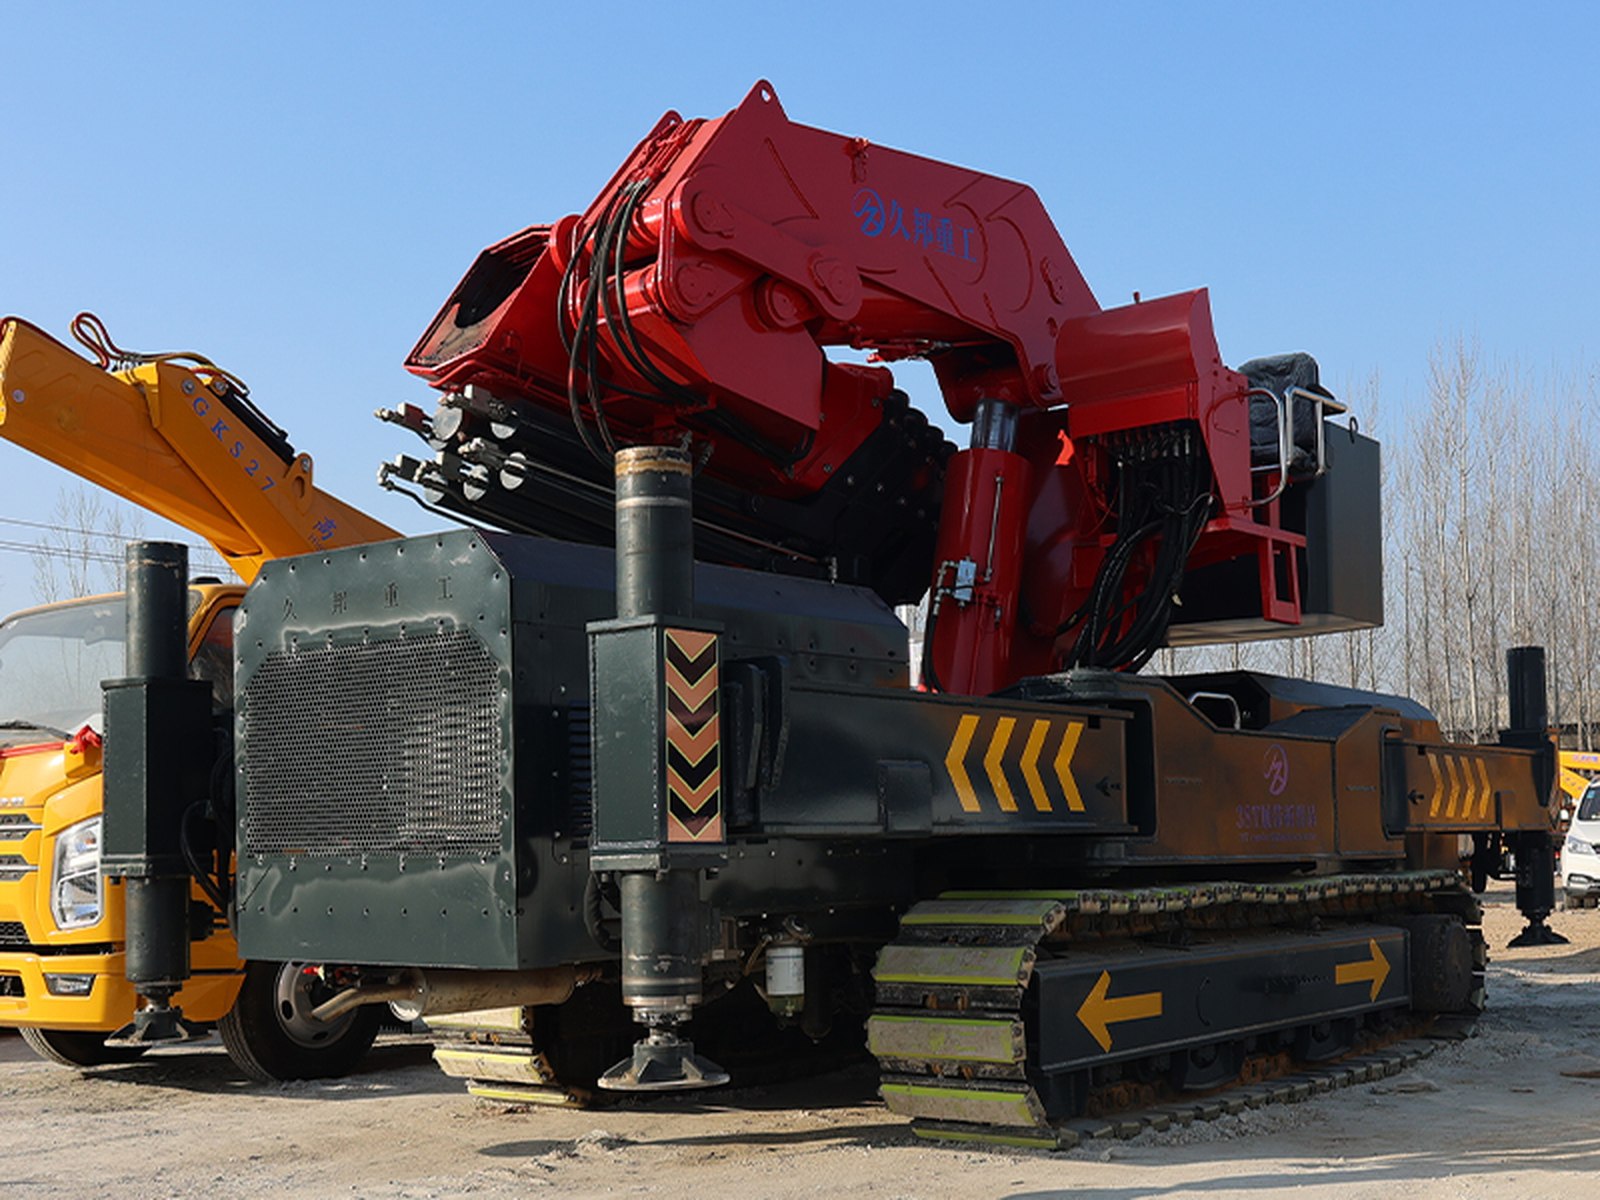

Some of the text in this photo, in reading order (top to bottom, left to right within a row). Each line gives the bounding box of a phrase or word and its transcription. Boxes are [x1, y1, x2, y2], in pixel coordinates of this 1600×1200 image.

[889, 199, 977, 262] 久邦重工
[192, 397, 276, 491] GKS27
